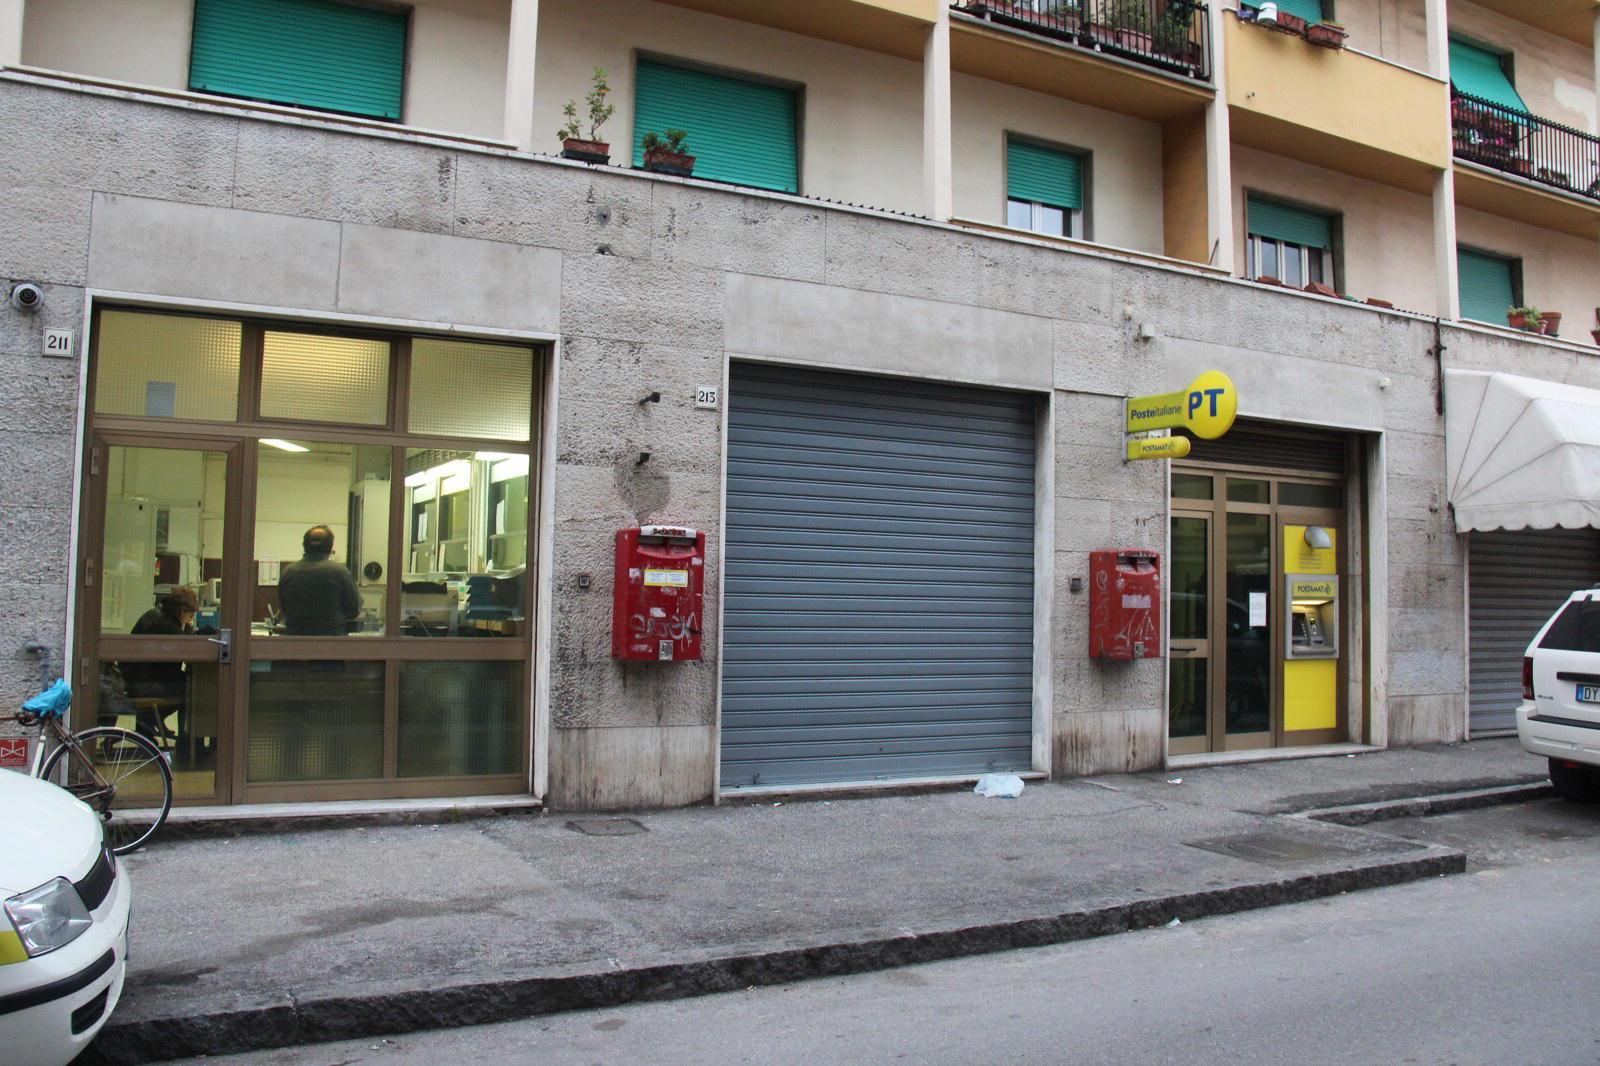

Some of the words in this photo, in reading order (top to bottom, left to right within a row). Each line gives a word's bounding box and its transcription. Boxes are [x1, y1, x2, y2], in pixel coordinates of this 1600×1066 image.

[48, 334, 68, 350] 211
[698, 390, 716, 403] 213
[1188, 388, 1225, 420] PT
[1142, 443, 1168, 453] POSTAMAT
[1297, 584, 1324, 593] POSTAMAT
[1584, 687, 1599, 701] DY
